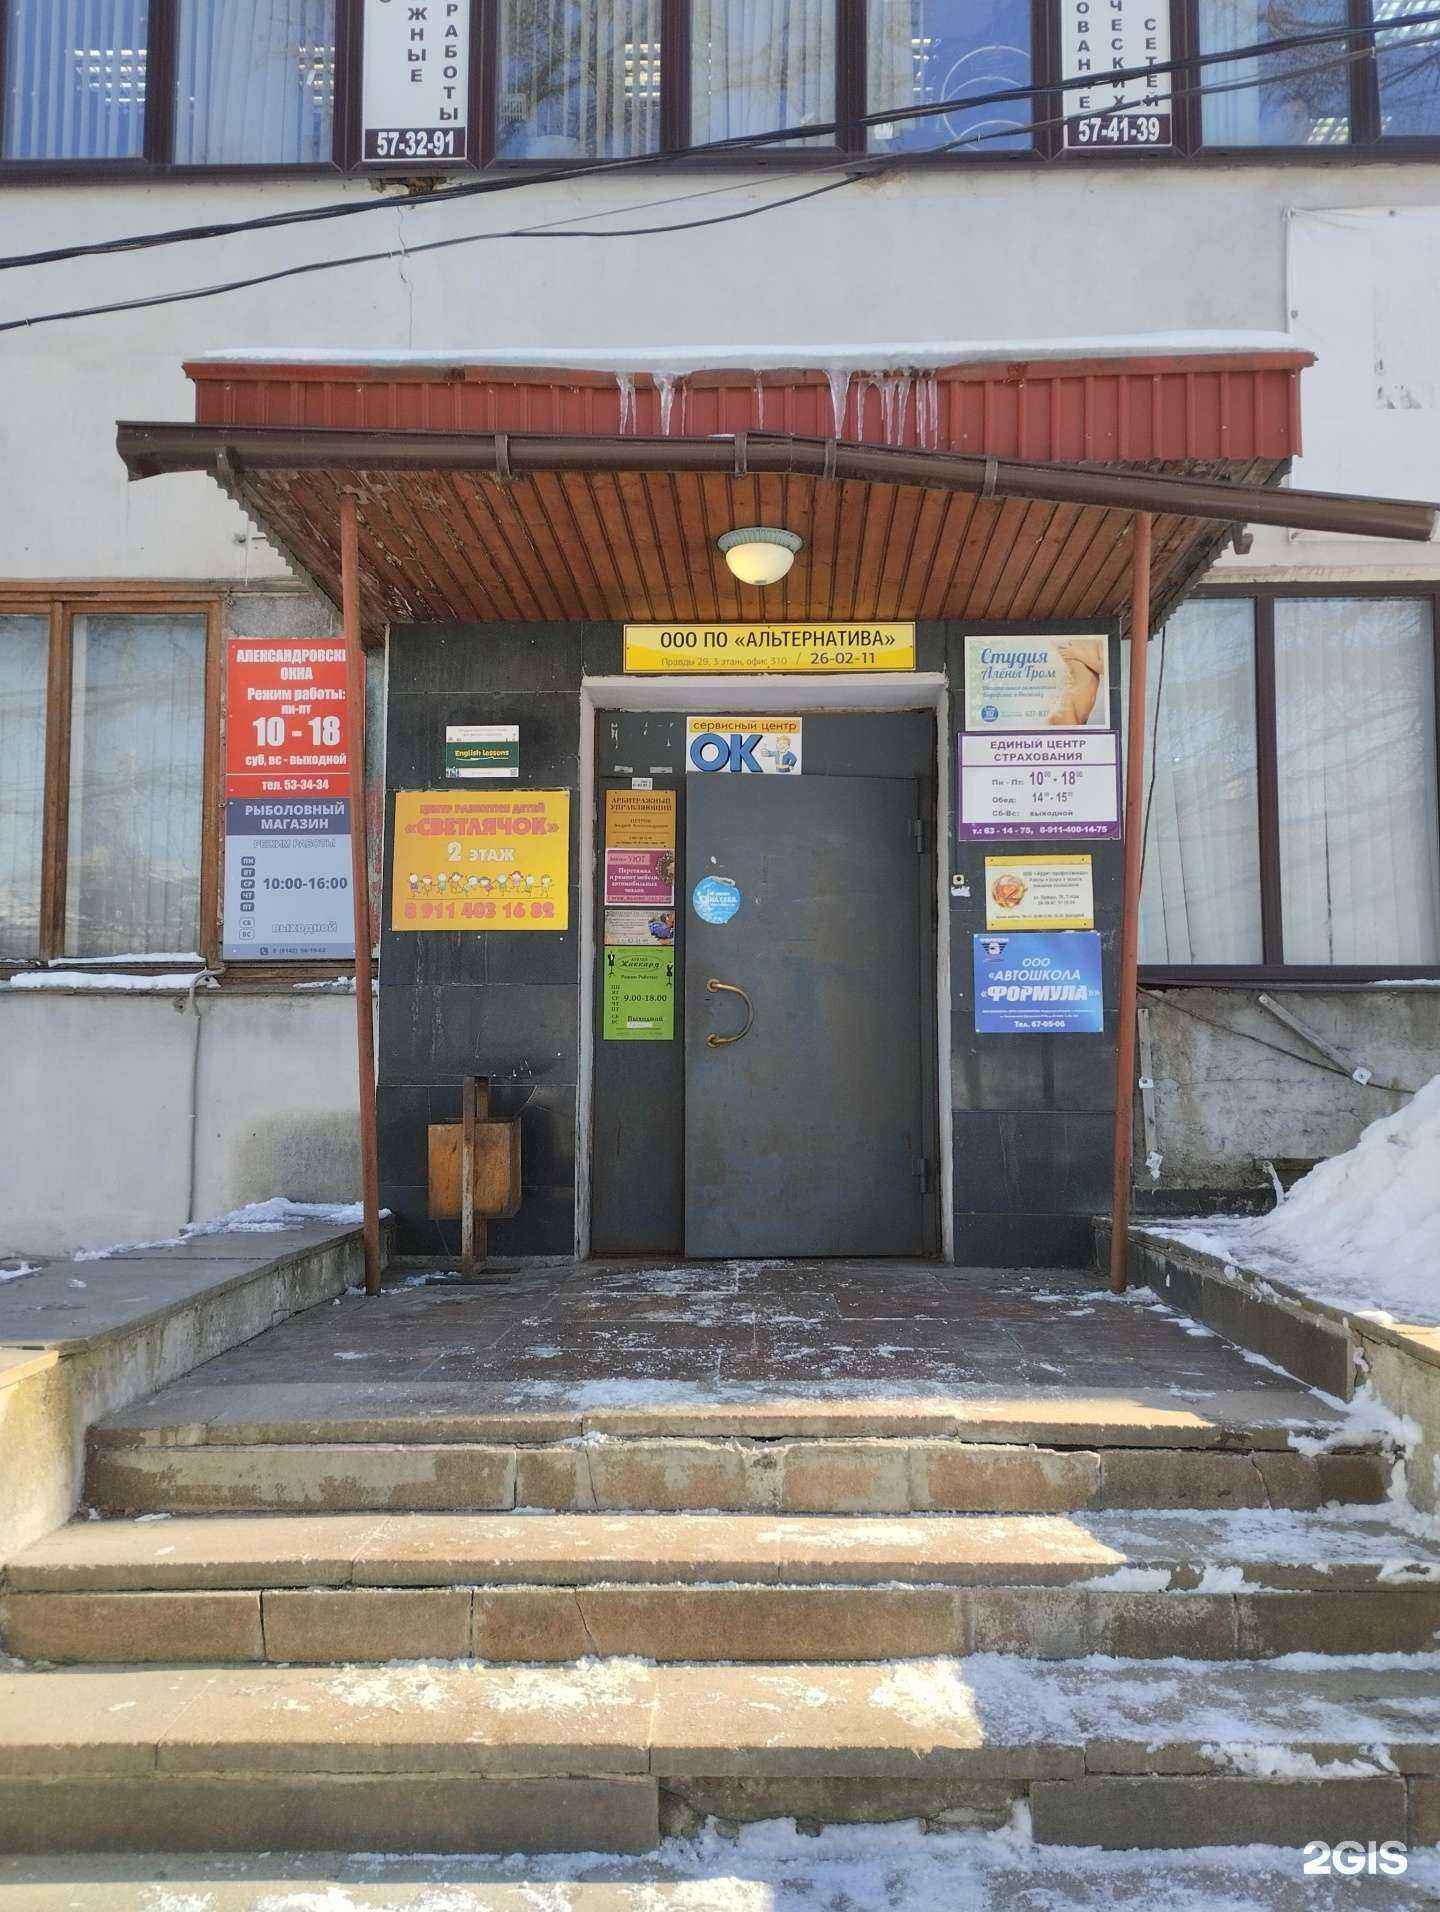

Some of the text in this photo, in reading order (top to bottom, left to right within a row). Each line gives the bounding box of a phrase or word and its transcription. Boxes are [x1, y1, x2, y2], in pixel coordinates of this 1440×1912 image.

[408, 0, 427, 82] ЖНЫЕ
[1076, 2, 1091, 108] ОВАНЕ
[1078, 117, 1160, 142] 57-41-39
[377, 132, 454, 155] 57-32-91
[660, 630, 896, 648] ООО ПО «АЛЬТЕРНАТИВА»
[810, 652, 876, 665] 26-02-11
[981, 648, 1048, 668] Студия
[280, 667, 313, 680] ОКНА
[247, 687, 346, 702] Режим работы:
[253, 716, 285, 746] 10
[308, 716, 341, 746] 18
[693, 720, 797, 732] сервисный центр
[690, 733, 763, 772] ОК
[990, 739, 1086, 751] ЕДИНЫЙ ЦЕНТР
[455, 749, 510, 758] English Lessons
[994, 752, 1083, 762] СТРАХОВАНИЯ
[245, 800, 345, 816] РЫБОЛОВНЫЙ
[260, 819, 329, 830] МАГАЗИН
[404, 817, 560, 836] «СВЕТЛЯЧОК»
[448, 841, 515, 862] 2 ЭТАЖ
[263, 877, 348, 890] 10:00-16:00
[404, 902, 417, 919] 8
[420, 902, 455, 919] 911
[503, 902, 526, 918] 16
[1022, 958, 1051, 967] ООО
